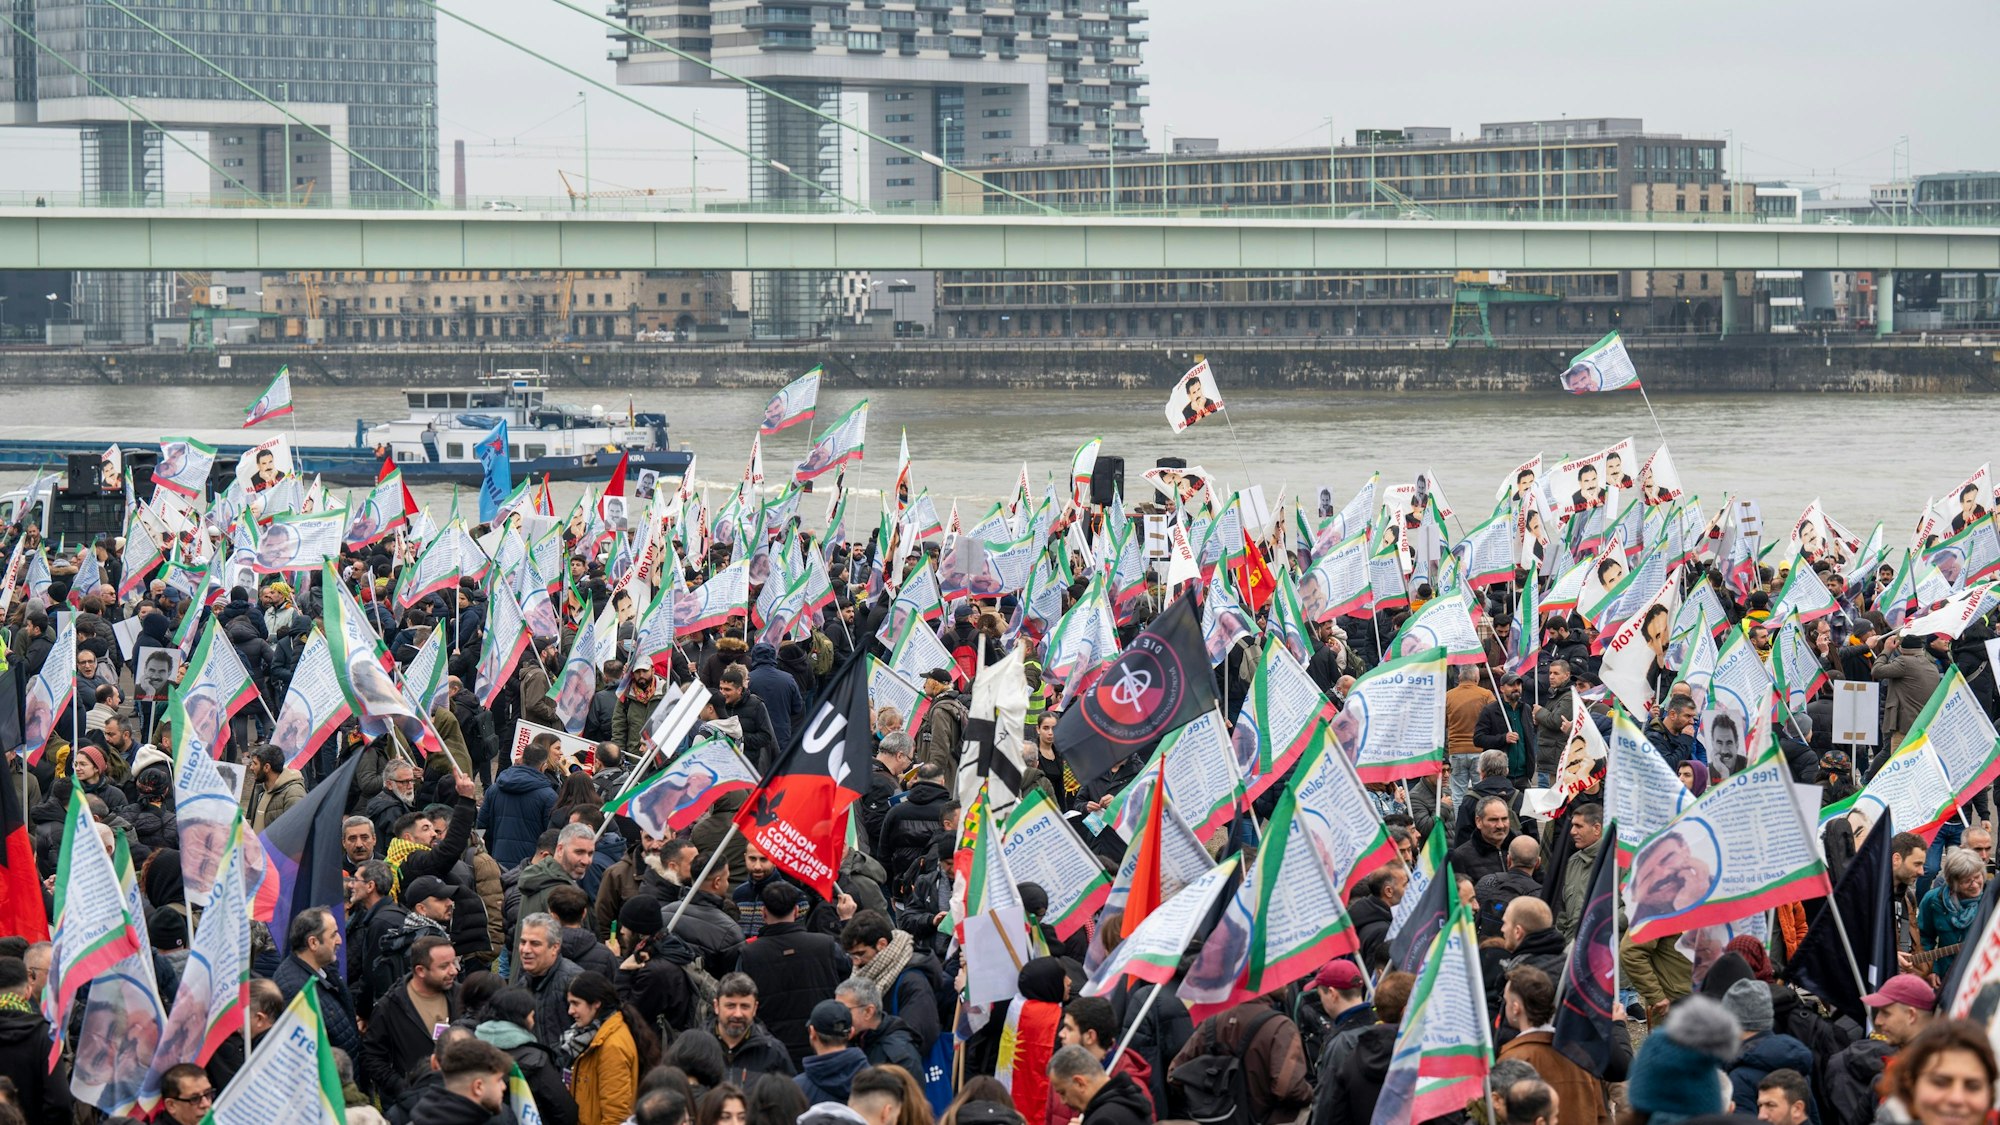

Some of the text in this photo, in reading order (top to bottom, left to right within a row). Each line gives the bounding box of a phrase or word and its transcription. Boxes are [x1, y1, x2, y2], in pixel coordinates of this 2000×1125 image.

[628, 454, 645, 462] KIRA
[1181, 546, 1192, 560] FOR
[1618, 736, 1636, 751] ree
[779, 820, 817, 854] UNION
[756, 832, 820, 881] LIBERTAIRE
[290, 1026, 316, 1054] Fre
[522, 1103, 542, 1125] Fre
